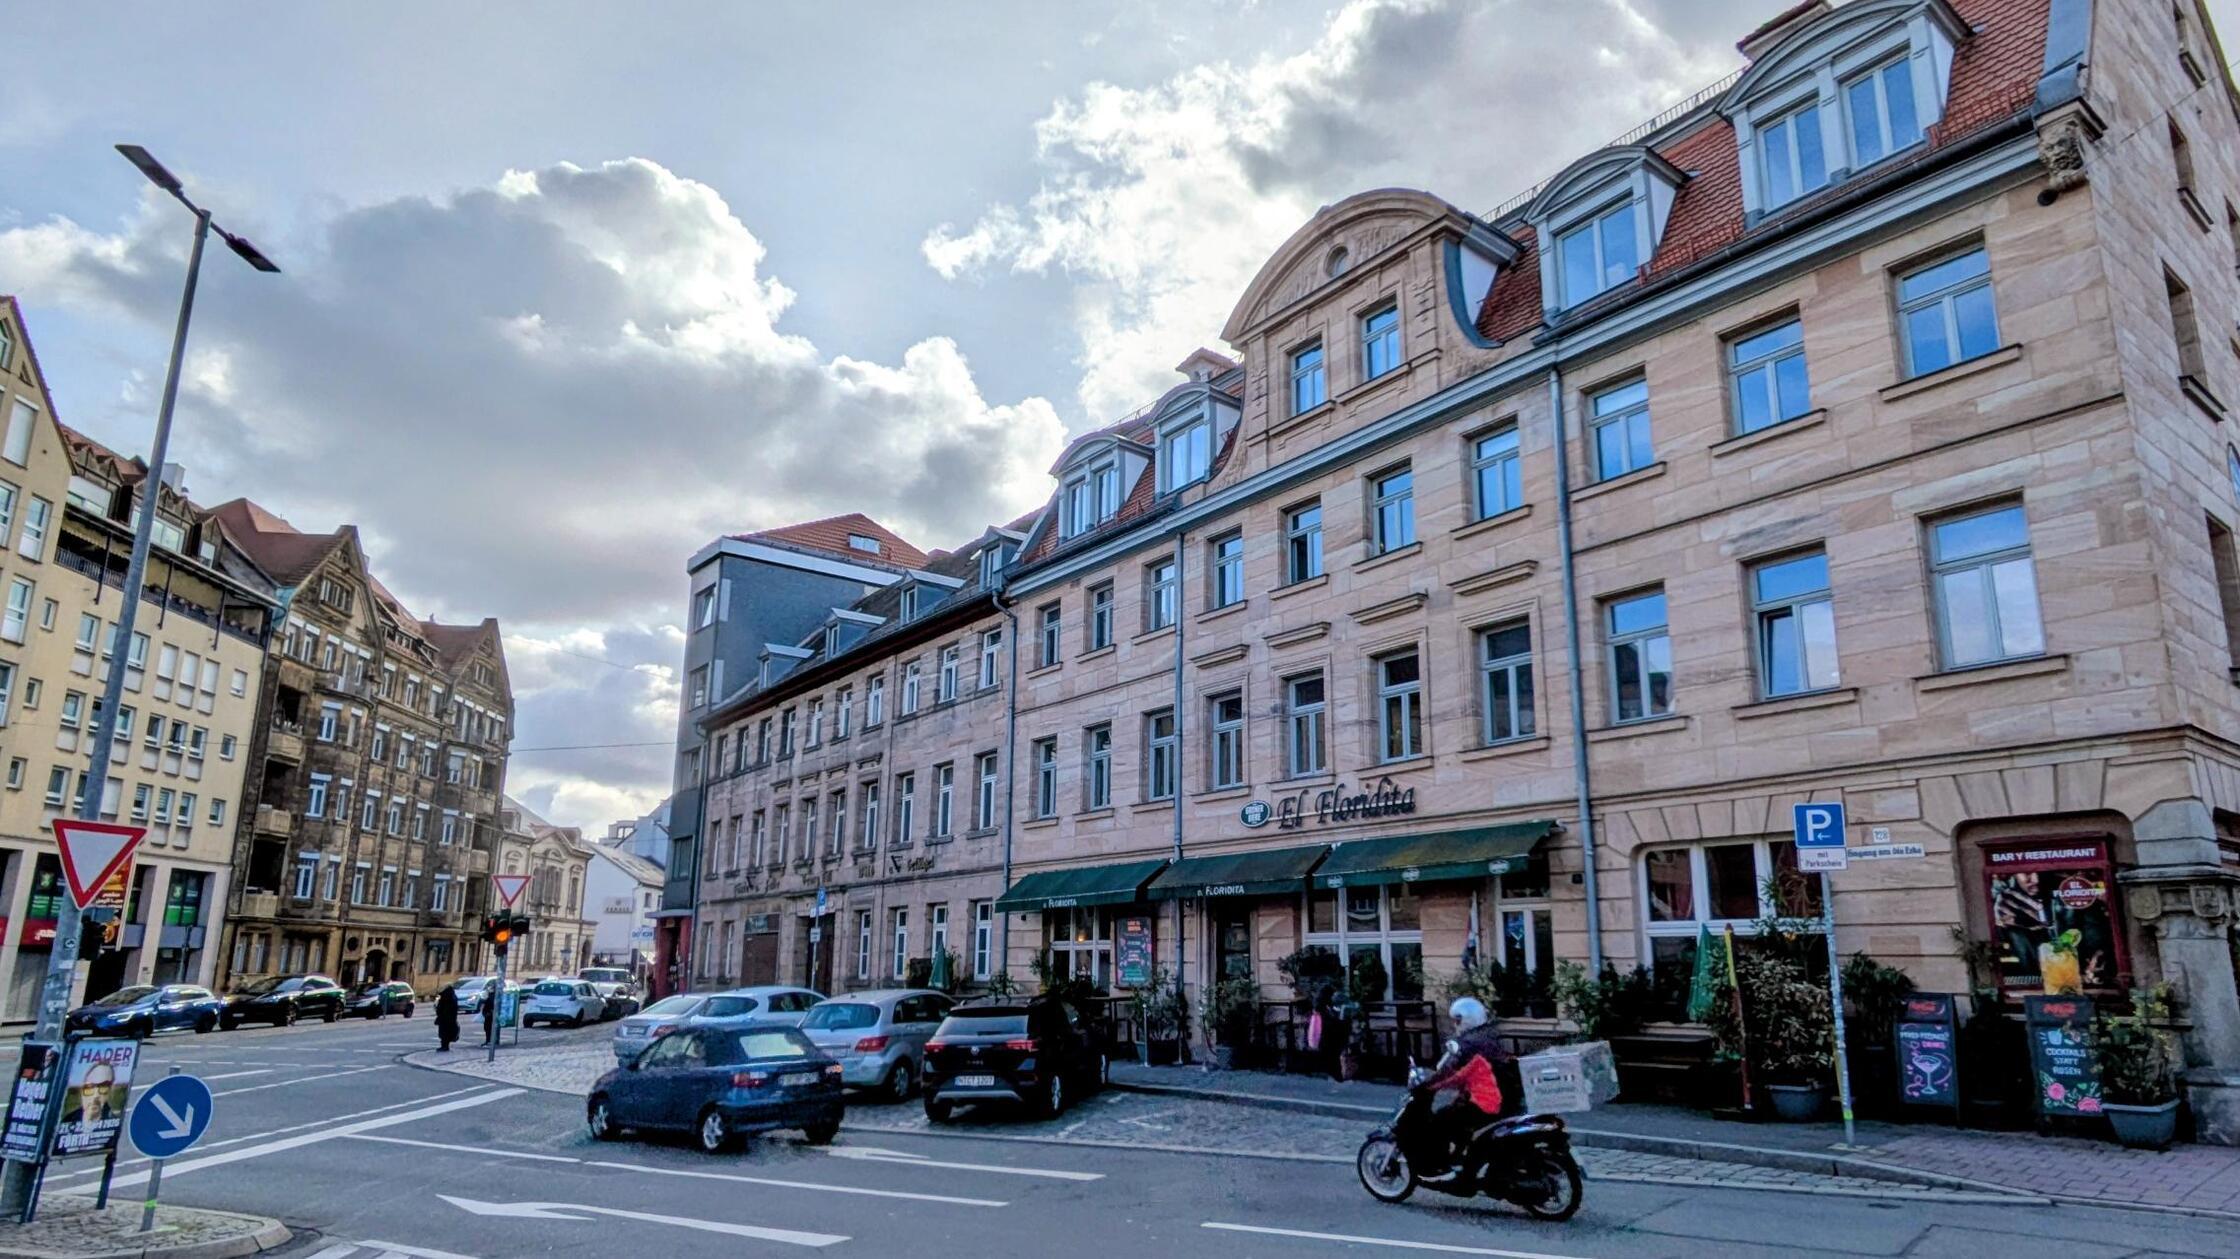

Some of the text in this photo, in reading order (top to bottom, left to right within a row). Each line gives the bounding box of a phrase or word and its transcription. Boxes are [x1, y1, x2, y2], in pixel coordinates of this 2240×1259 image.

[1277, 776, 1417, 830] El Floridita
[1805, 809, 1832, 842] P
[1992, 847, 2096, 862] BAR Y RESTAURANT
[1205, 885, 1245, 897] FLORIDITA
[2069, 881, 2082, 889] EL
[2045, 1047, 2087, 1058] COCKTAILS
